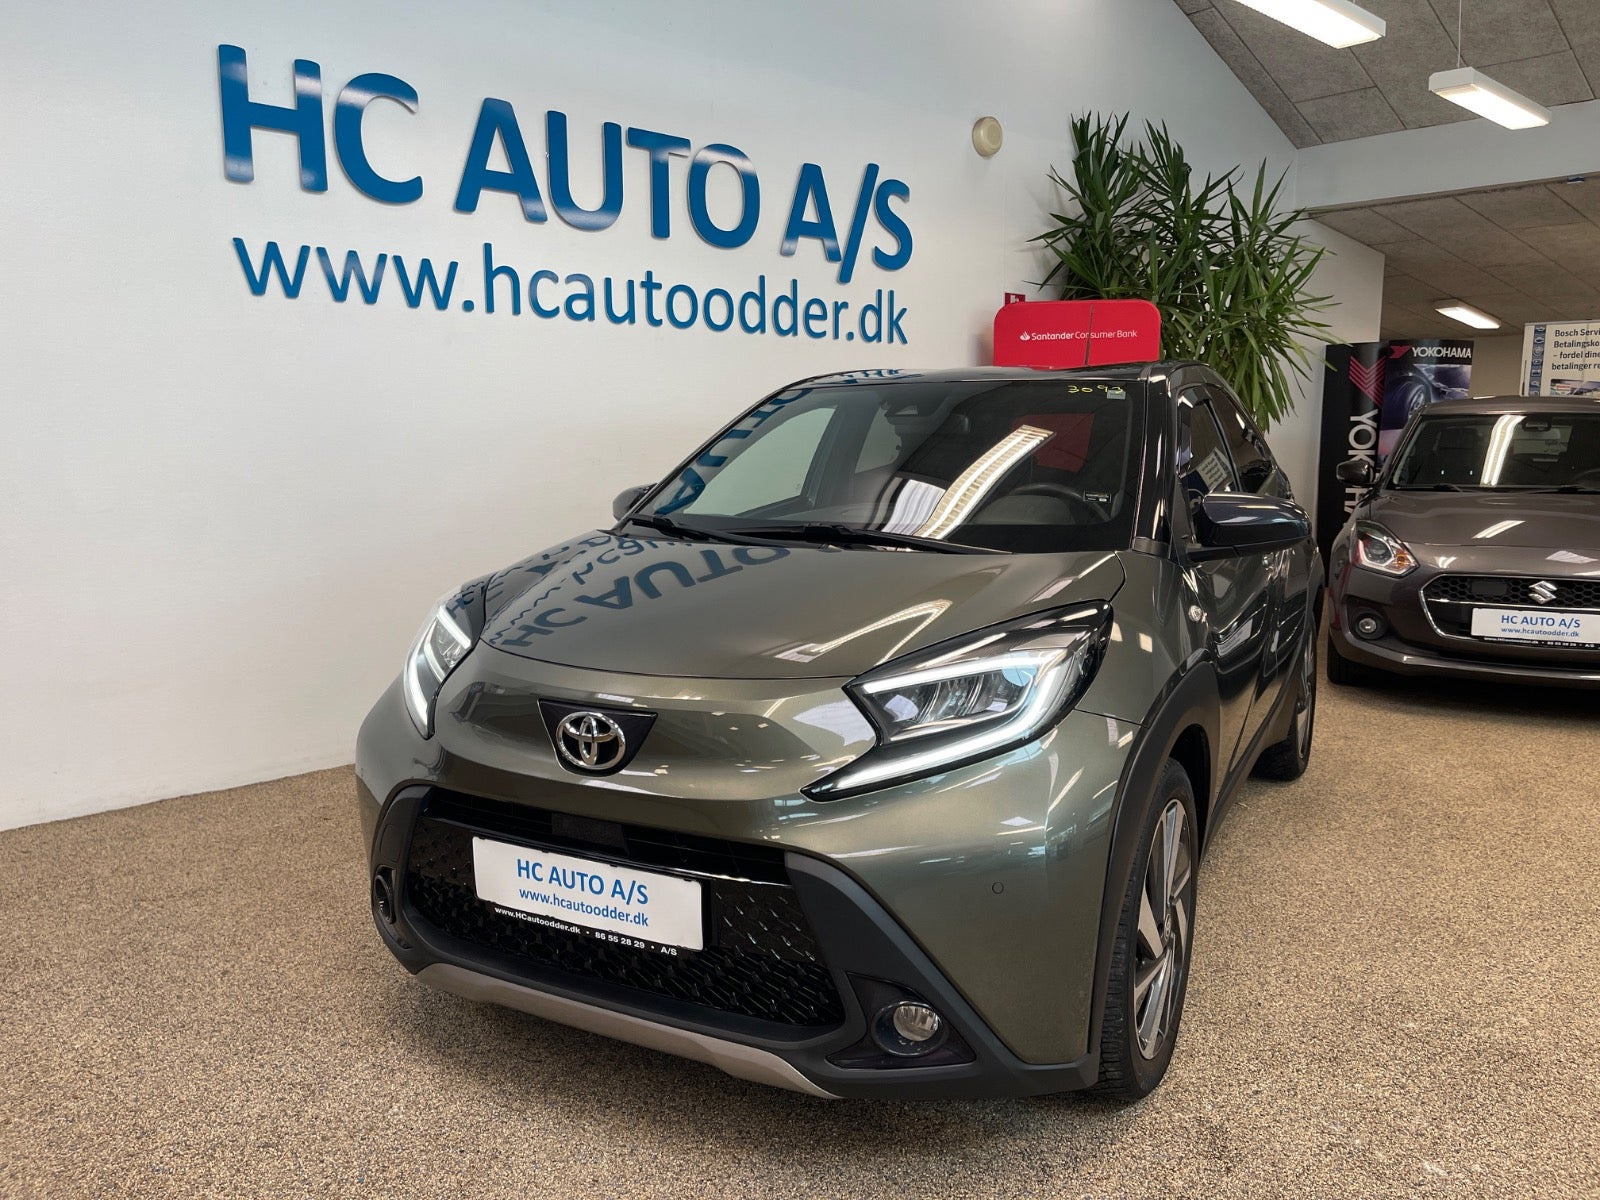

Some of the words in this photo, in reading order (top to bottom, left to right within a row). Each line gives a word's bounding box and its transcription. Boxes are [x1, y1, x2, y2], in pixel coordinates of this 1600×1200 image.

[217, 44, 423, 204] HC
[455, 98, 760, 250] AUTO
[780, 163, 913, 284] A/S
[233, 237, 908, 345] www.hcautoodder.dk
[1032, 331, 1074, 341] Santander
[1117, 330, 1137, 338] Bank
[1555, 329, 1578, 337] Bosch
[1412, 346, 1471, 358] YOKOHAMA
[1560, 351, 1583, 359] fordel
[1552, 362, 1592, 371] betalinger
[1501, 615, 1518, 625] HC
[1521, 616, 1555, 627] AUTO
[1558, 618, 1581, 628] A/S
[516, 859, 543, 883] HC
[549, 866, 605, 896] AUTO
[611, 879, 649, 906] A/S
[519, 888, 649, 927] www.hcautoodder.dk
[494, 906, 581, 934] www.HCautoodder.dk
[595, 931, 606, 940] 86
[608, 934, 618, 943] 55
[621, 937, 632, 946] 28
[634, 940, 645, 949] 29
[661, 946, 677, 956] A/S
